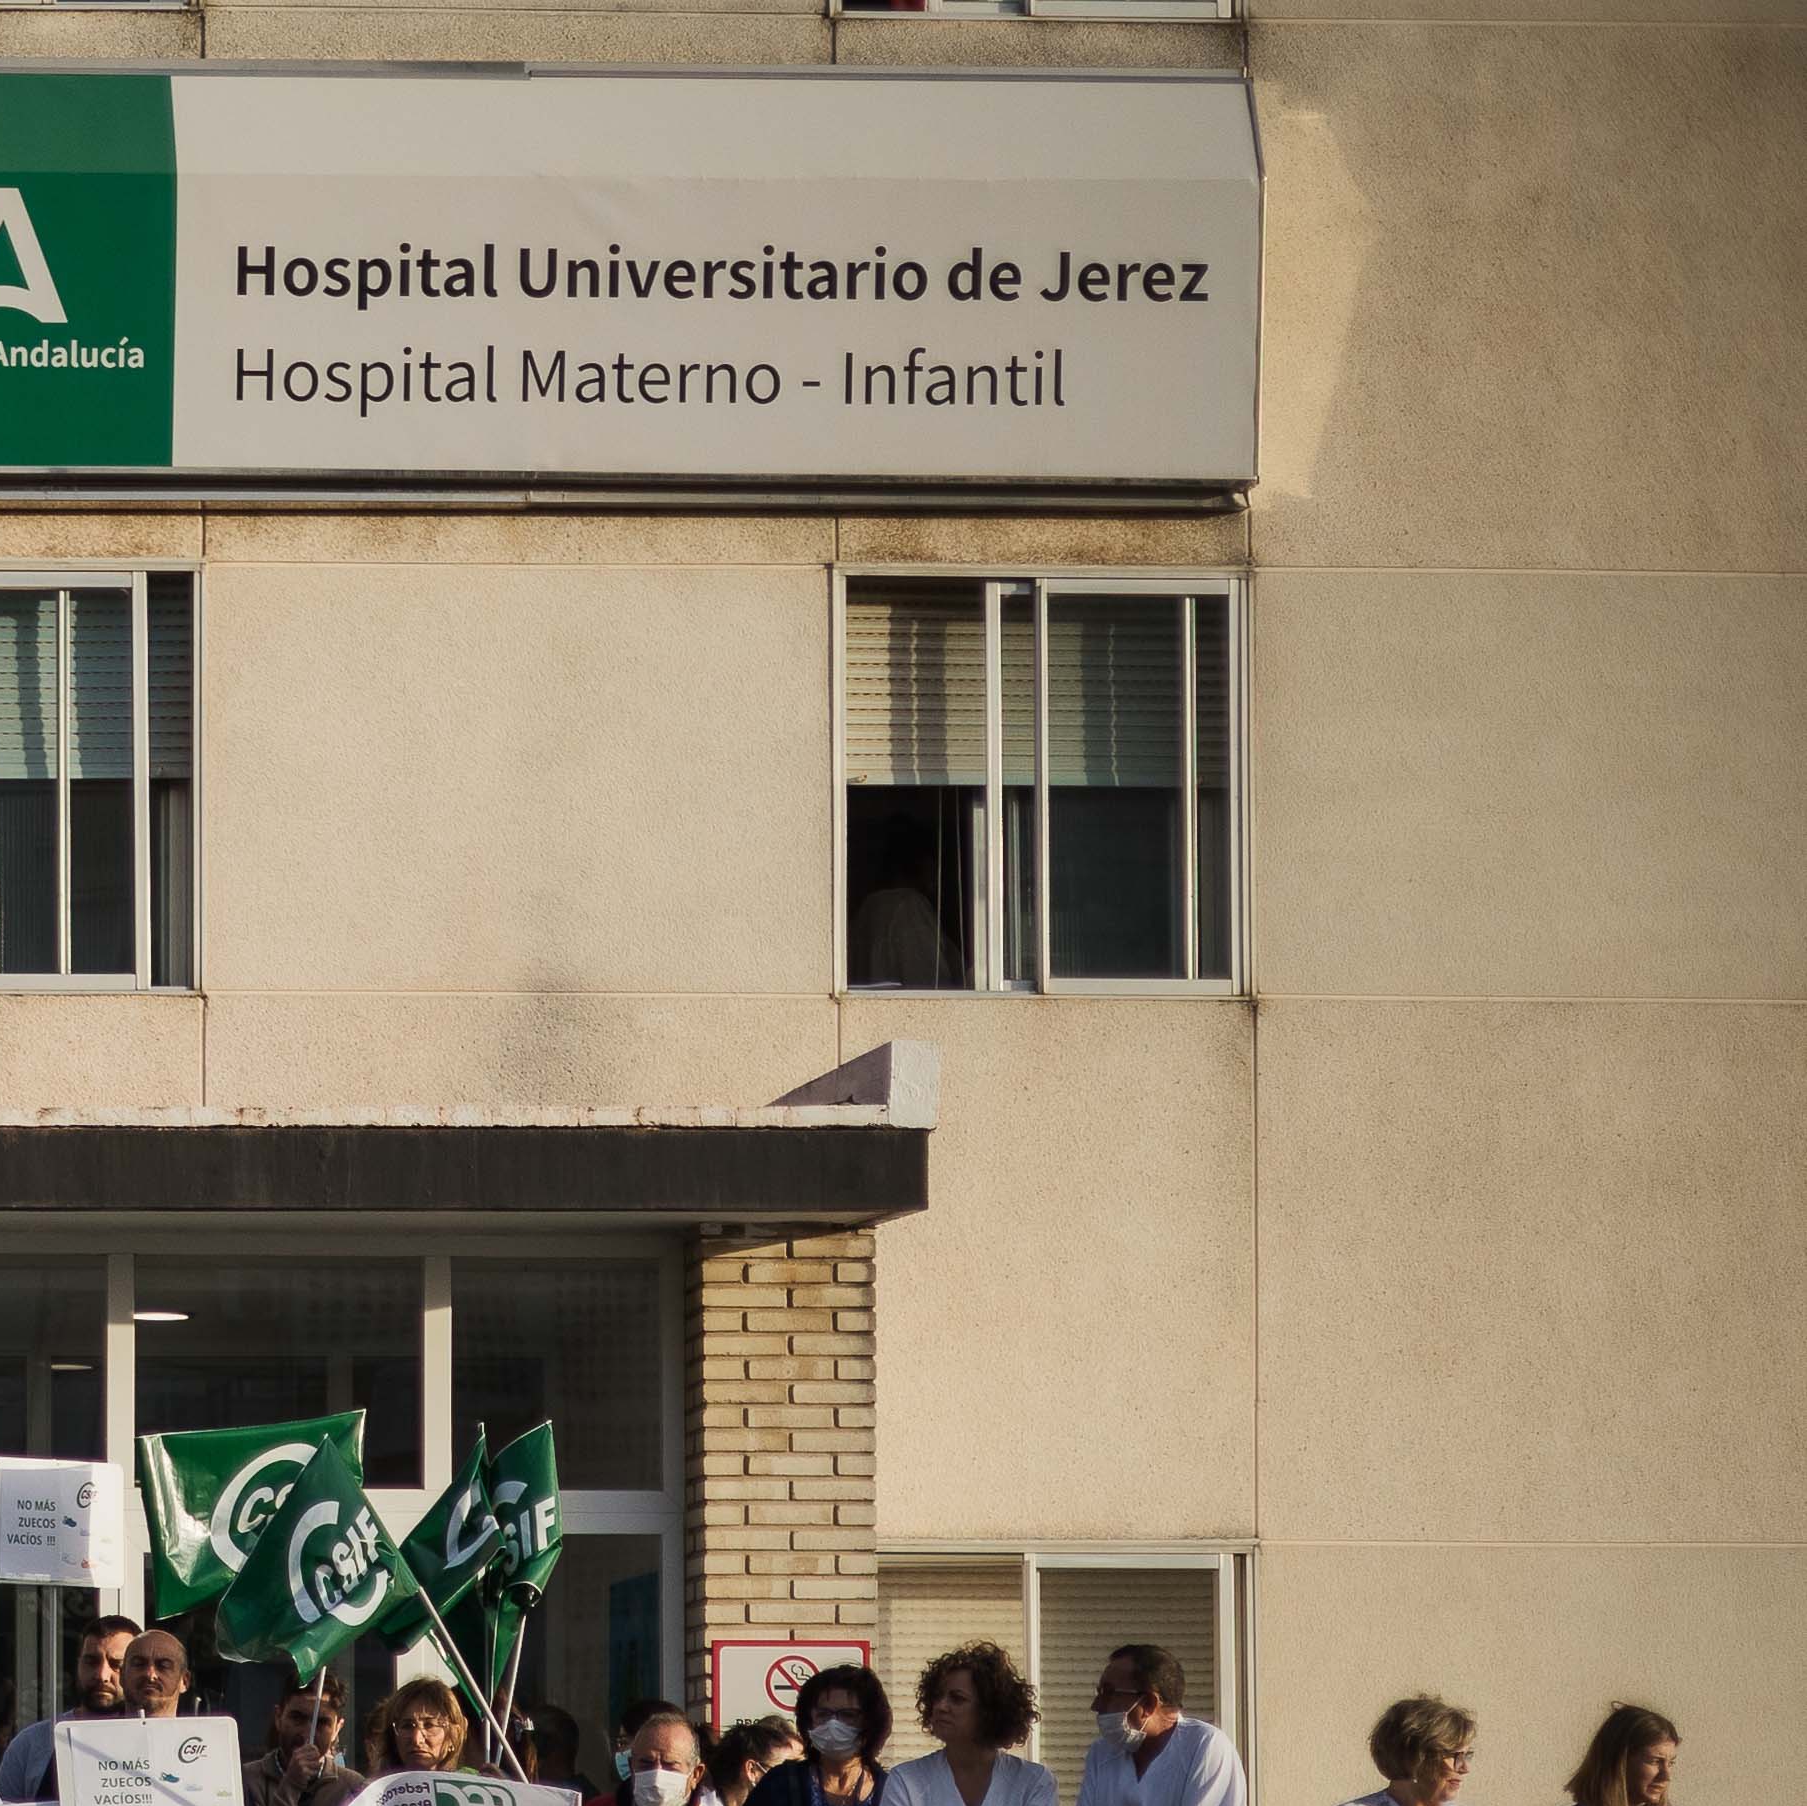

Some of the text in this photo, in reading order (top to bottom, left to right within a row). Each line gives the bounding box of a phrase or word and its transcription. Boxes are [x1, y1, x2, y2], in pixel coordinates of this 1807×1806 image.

[237, 243, 1209, 310] Hospital Universitario de Jerez
[236, 345, 497, 417] Hospital
[522, 350, 781, 404] Materno
[845, 347, 1065, 407] Infantil
[17, 1499, 56, 1511] NO MÁS
[18, 1517, 56, 1529] ZUECOS
[7, 1531, 56, 1545] VACÍOS !!!
[99, 1758, 150, 1770] NO MÁS
[101, 1776, 151, 1787] ZUECOS
[94, 1792, 152, 1805] VACÍOS!!!
